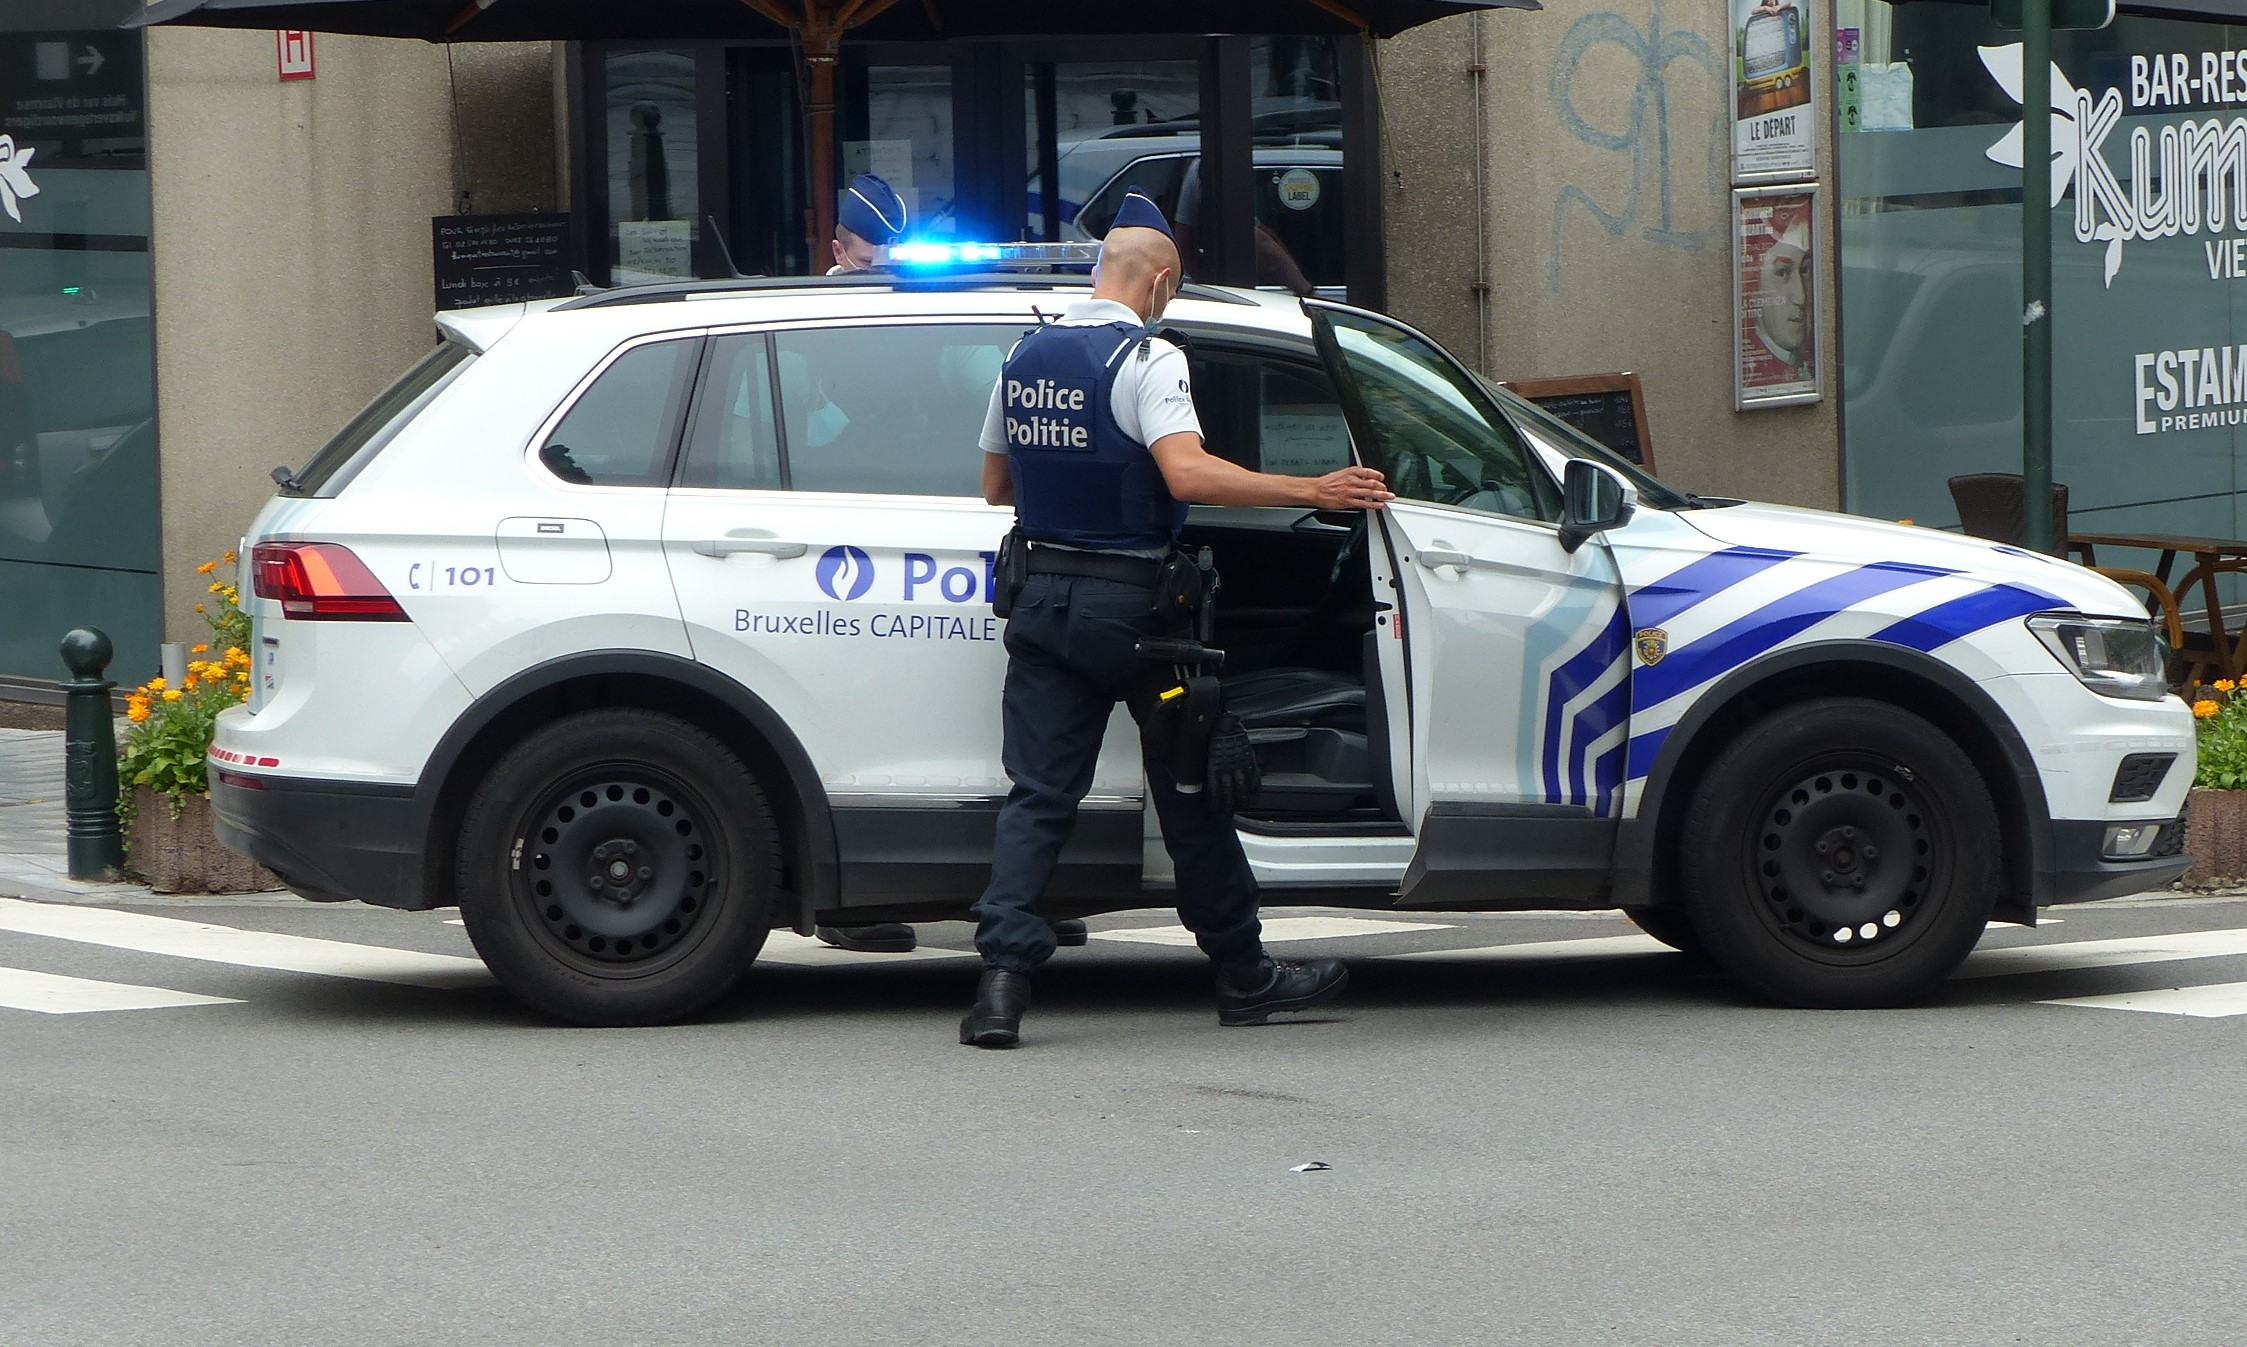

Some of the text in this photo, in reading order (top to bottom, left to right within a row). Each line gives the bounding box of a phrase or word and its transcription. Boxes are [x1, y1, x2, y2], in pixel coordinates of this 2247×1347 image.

[1750, 121, 1761, 141] LE
[1288, 191, 1311, 201] LABEL
[2205, 238, 2247, 280] VIE
[1007, 379, 1085, 410] Police
[1006, 416, 1088, 448] Politie
[445, 567, 495, 586] 101
[735, 609, 997, 641] Bruxelles CAPITALE
